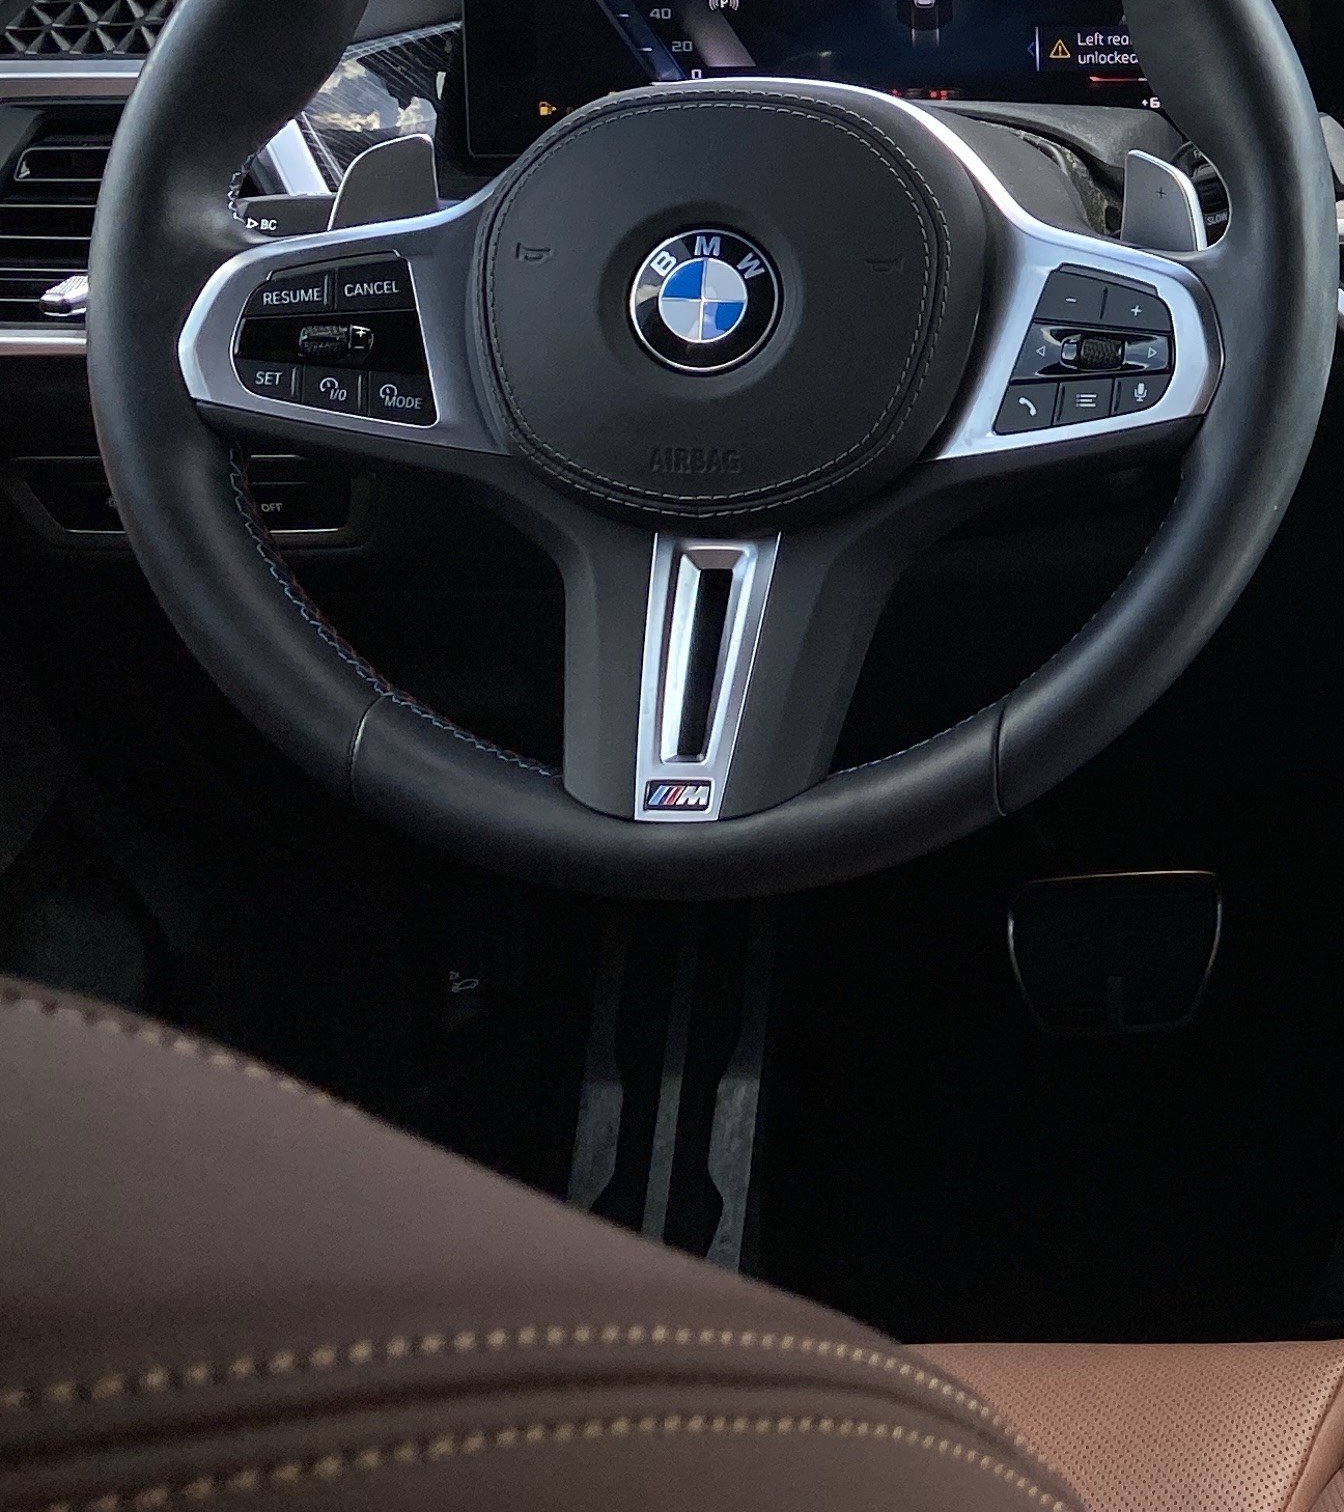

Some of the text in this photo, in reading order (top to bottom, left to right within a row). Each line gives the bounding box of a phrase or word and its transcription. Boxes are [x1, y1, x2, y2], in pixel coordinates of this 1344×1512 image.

[650, 8, 671, 19] 40
[1077, 32, 1132, 46] Left rea
[672, 41, 693, 52] 20
[261, 218, 277, 230] BC
[650, 236, 765, 279] BMW
[262, 287, 322, 305] RESUME
[344, 281, 400, 297] CANCEL
[255, 371, 283, 386] SET
[385, 396, 422, 409] MODE
[652, 447, 742, 474] AIRBAG
[261, 503, 283, 513] OFF
